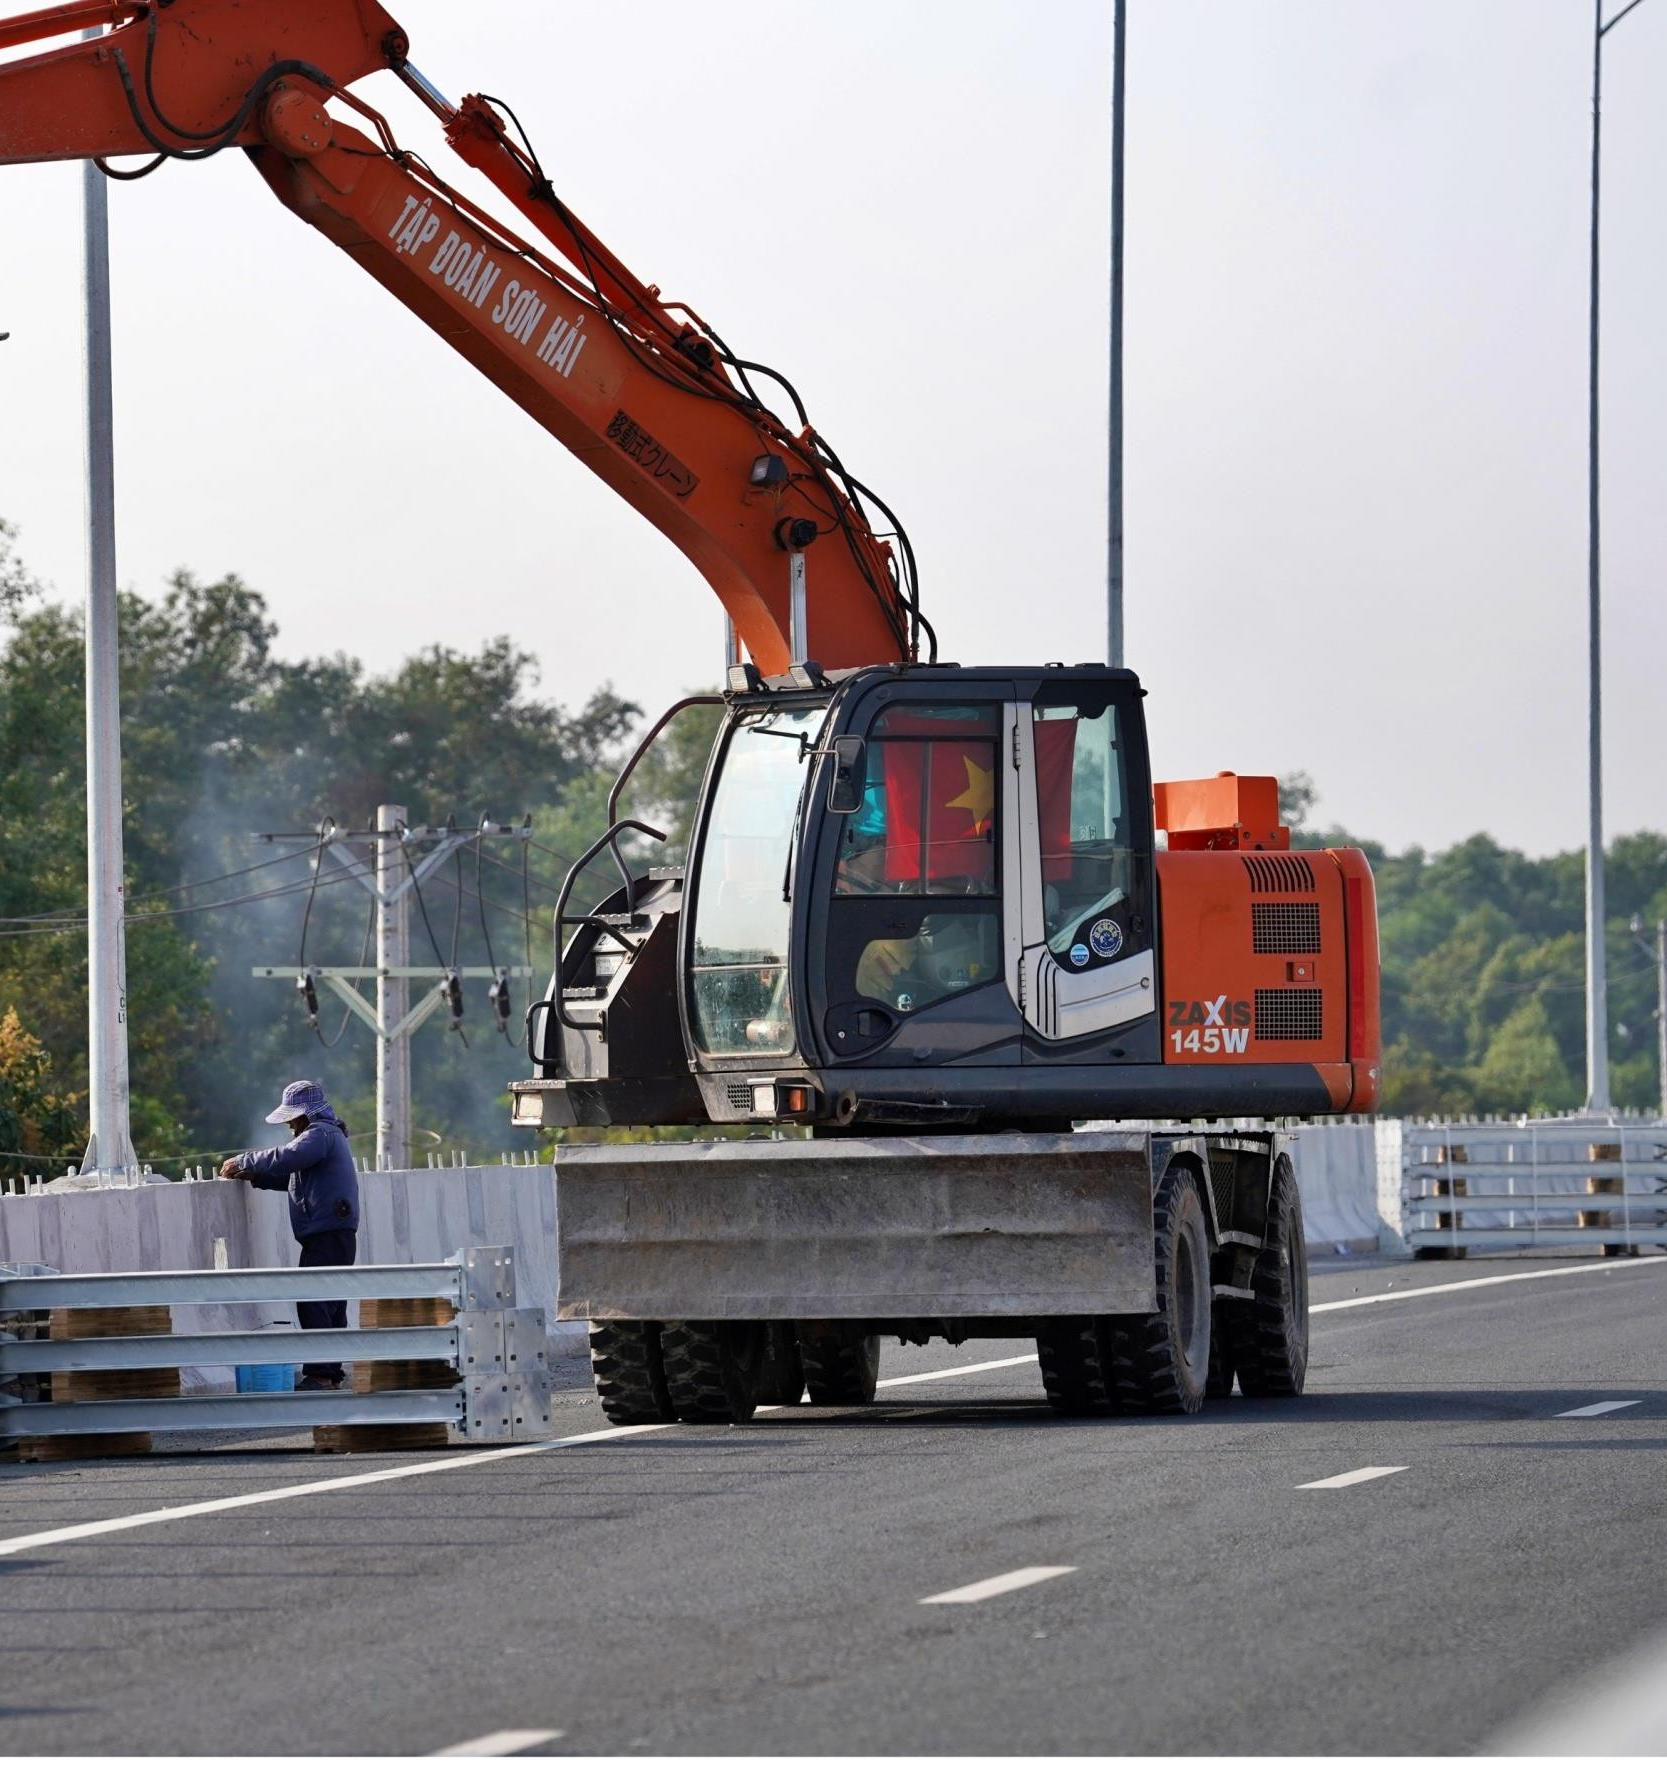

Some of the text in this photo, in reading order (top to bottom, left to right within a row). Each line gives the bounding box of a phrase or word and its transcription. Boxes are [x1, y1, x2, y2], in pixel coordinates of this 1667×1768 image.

[388, 194, 587, 378] TẬP ĐOÀN SƠN HẢI
[1169, 994, 1251, 1027] ZAXIS
[1170, 1028, 1249, 1053] 145W
